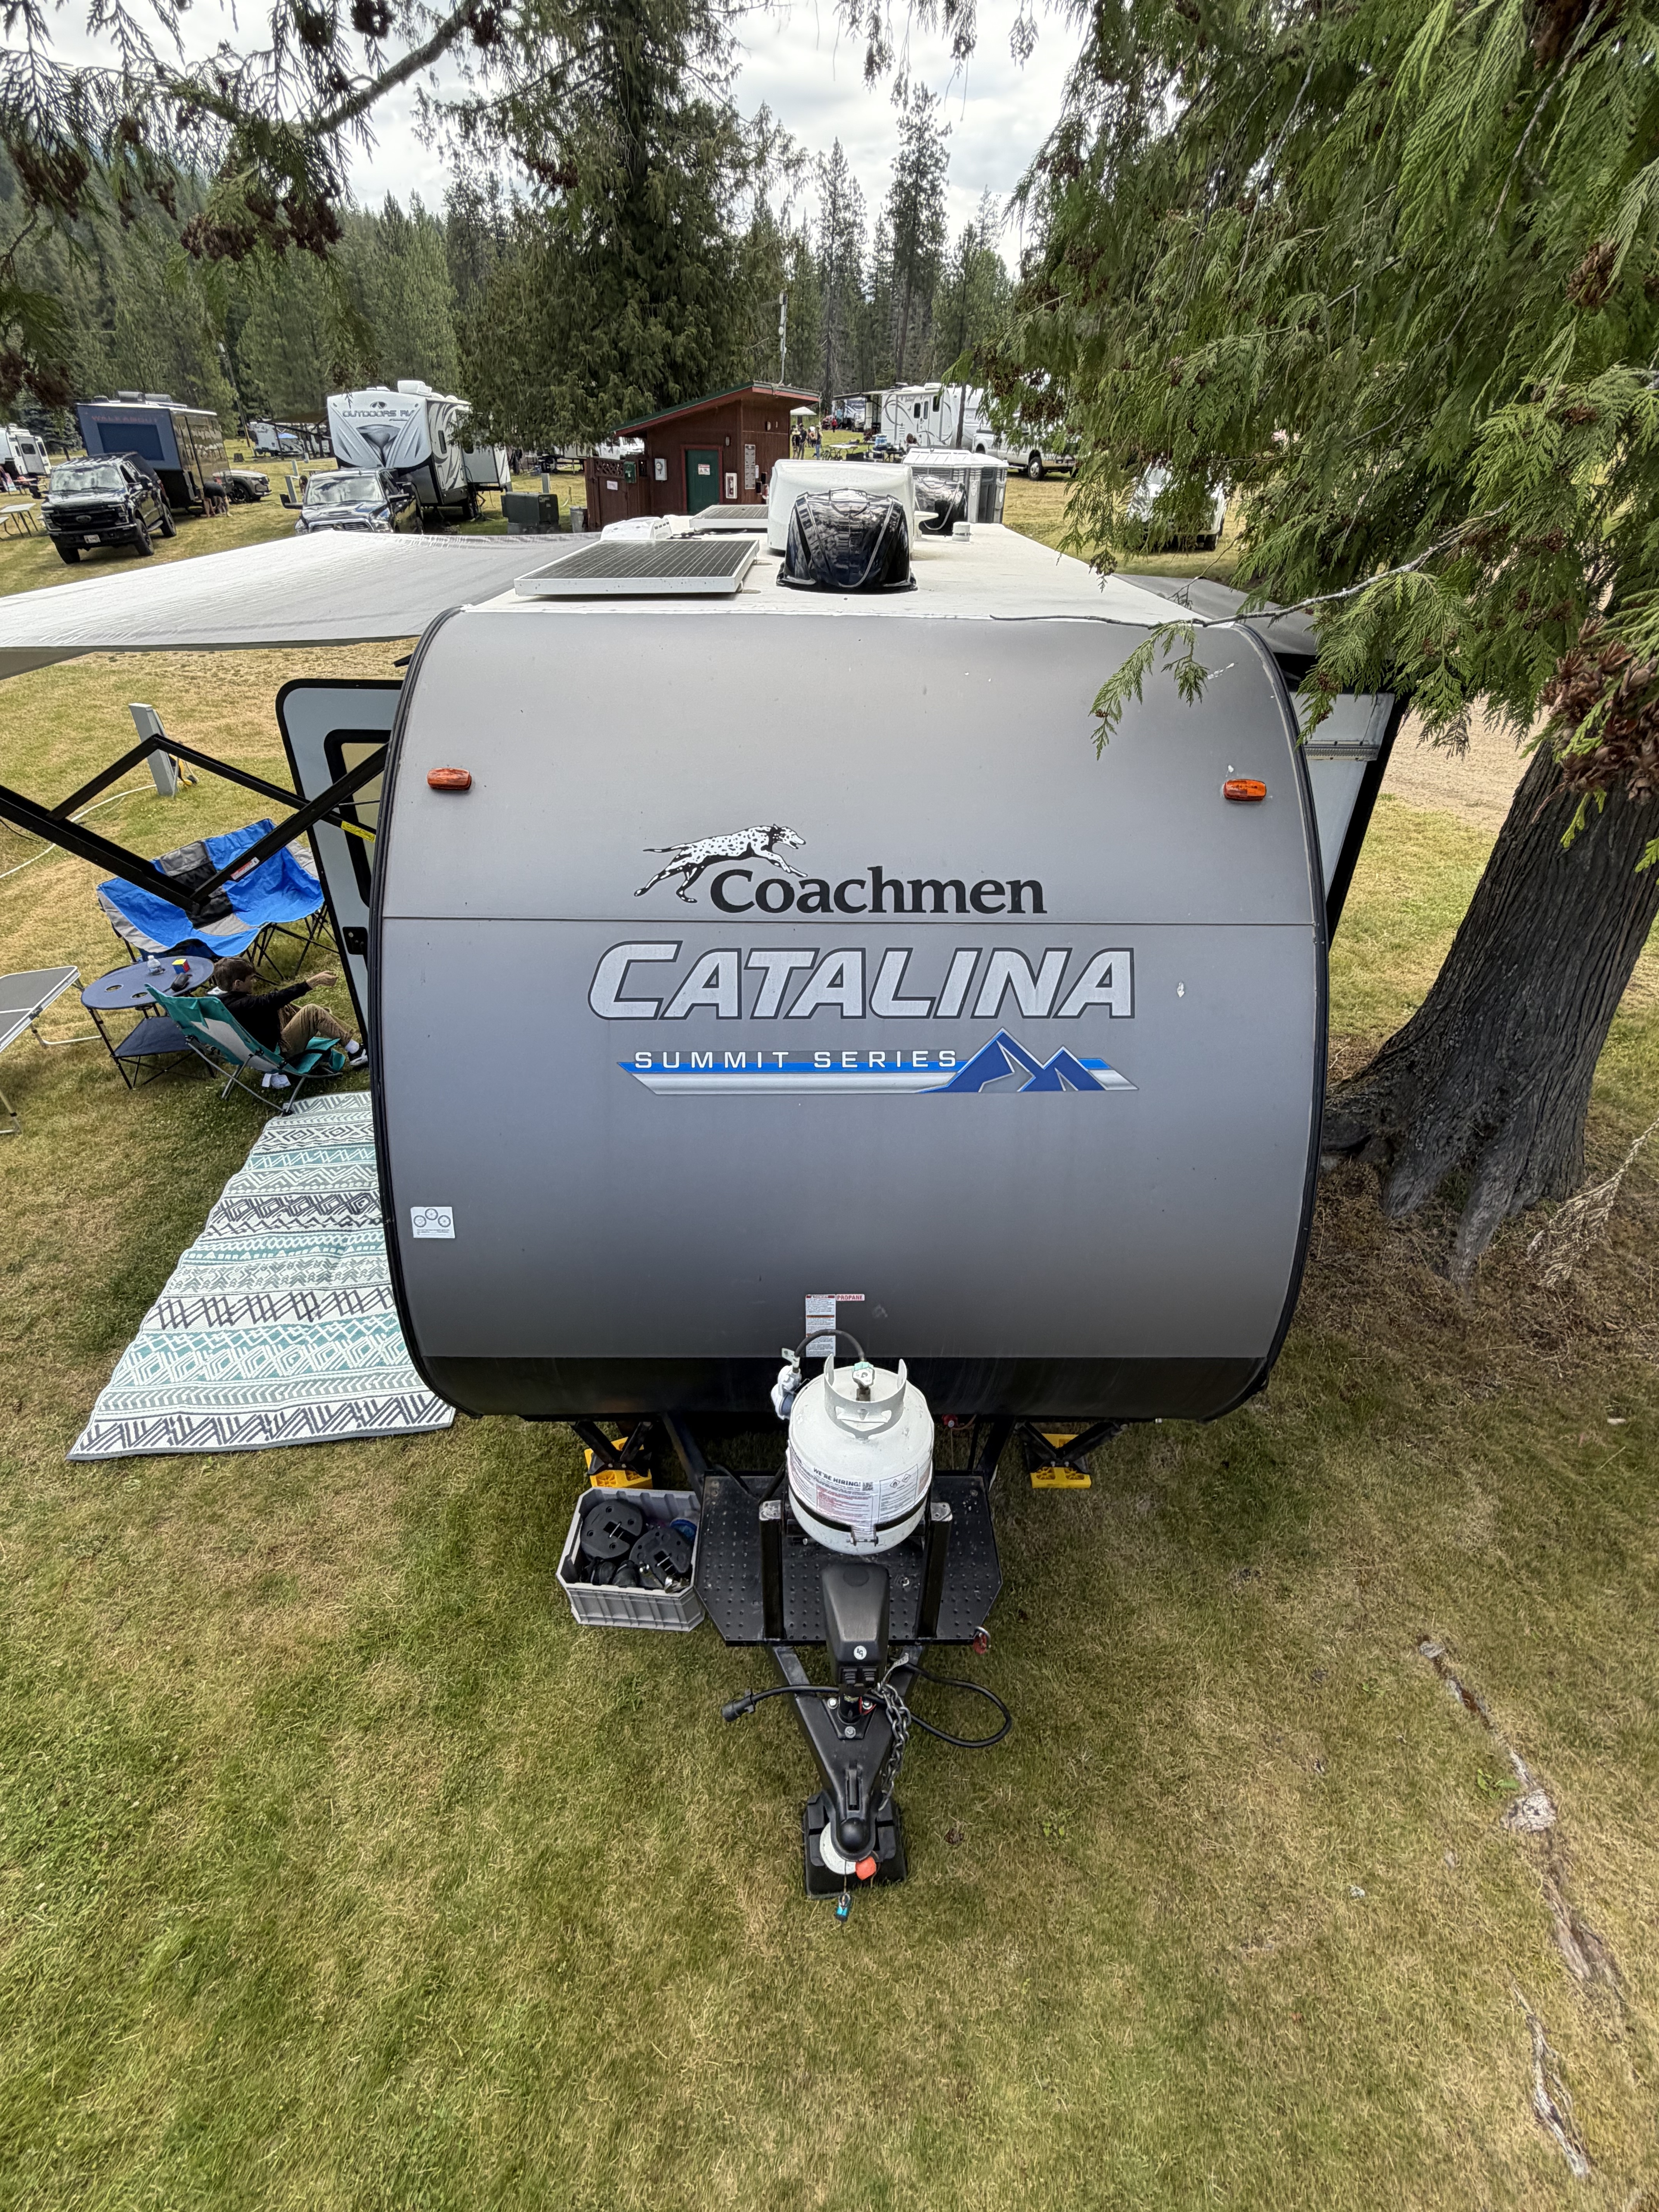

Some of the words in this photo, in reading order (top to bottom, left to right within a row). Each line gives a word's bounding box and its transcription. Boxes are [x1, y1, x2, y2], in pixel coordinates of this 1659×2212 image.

[710, 866, 1047, 914] Coachmen
[588, 941, 1135, 1020] CATALINA
[634, 1051, 789, 1069] SUMMIT
[814, 1050, 957, 1069] SERIES
[814, 1467, 832, 1480] WE'RE
[833, 1477, 861, 1487] HIRING!
